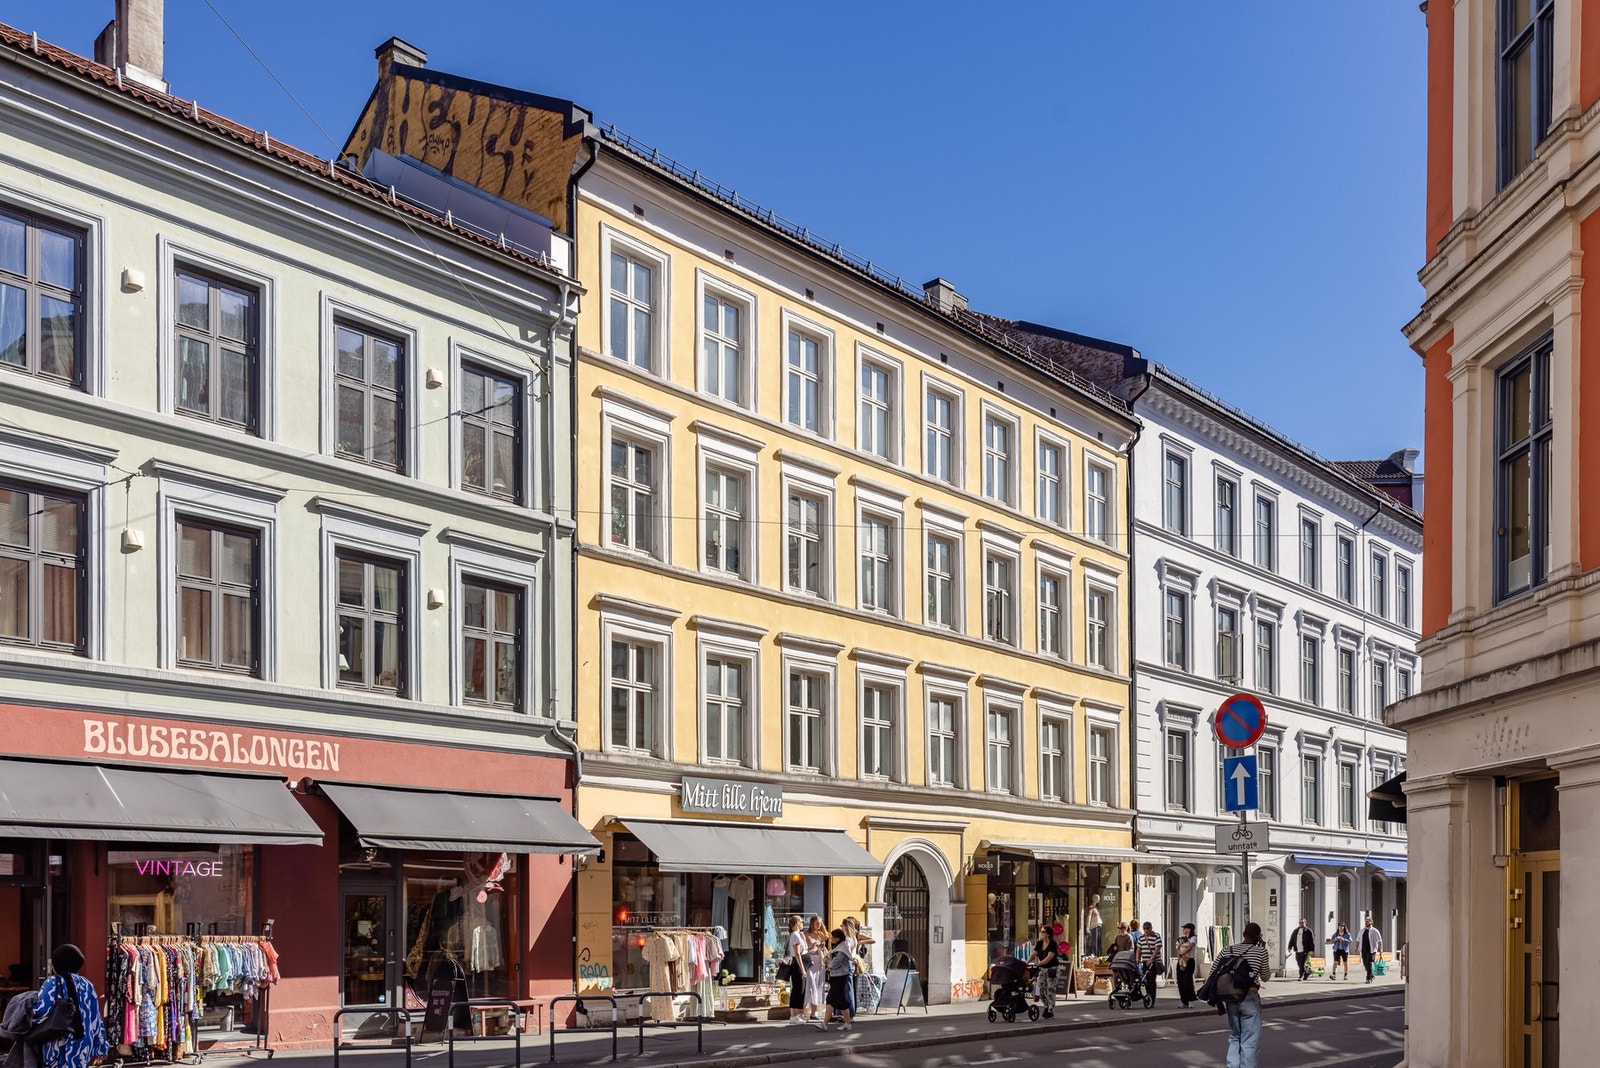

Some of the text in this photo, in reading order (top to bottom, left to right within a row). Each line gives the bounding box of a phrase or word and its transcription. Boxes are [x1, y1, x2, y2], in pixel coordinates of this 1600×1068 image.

[83, 719, 340, 772] BLUSESALONGEN
[683, 781, 782, 820] Mitt lille hjem
[1228, 842, 1258, 851] unntat
[135, 859, 223, 877] VINTAGE
[1210, 877, 1230, 888] EVE
